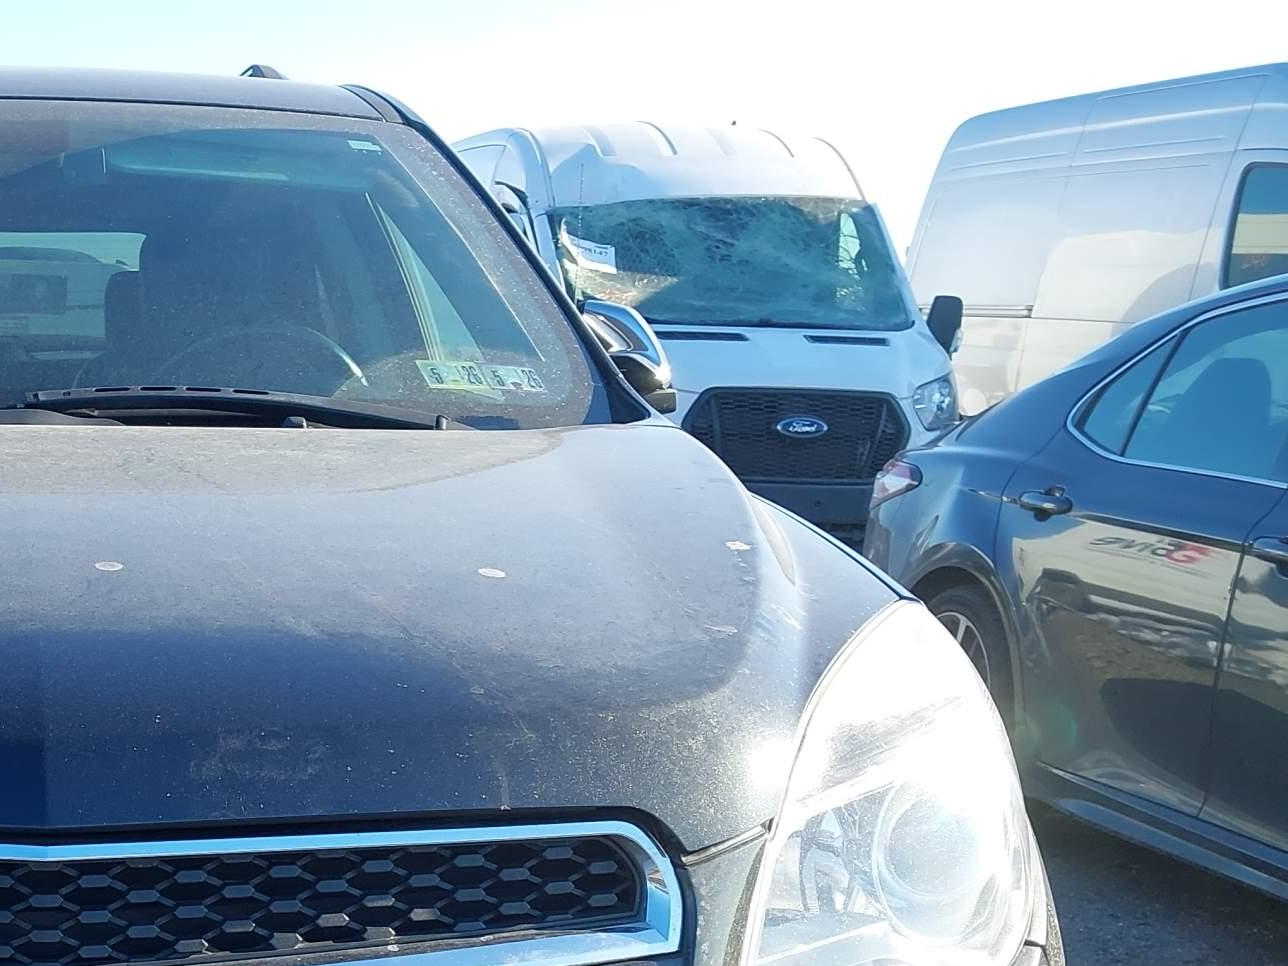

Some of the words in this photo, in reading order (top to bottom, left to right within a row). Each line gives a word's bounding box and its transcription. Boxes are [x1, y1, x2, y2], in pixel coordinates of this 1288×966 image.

[428, 366, 445, 385] 5
[460, 364, 483, 386] 26
[490, 369, 505, 387] 5
[520, 368, 544, 389] 26
